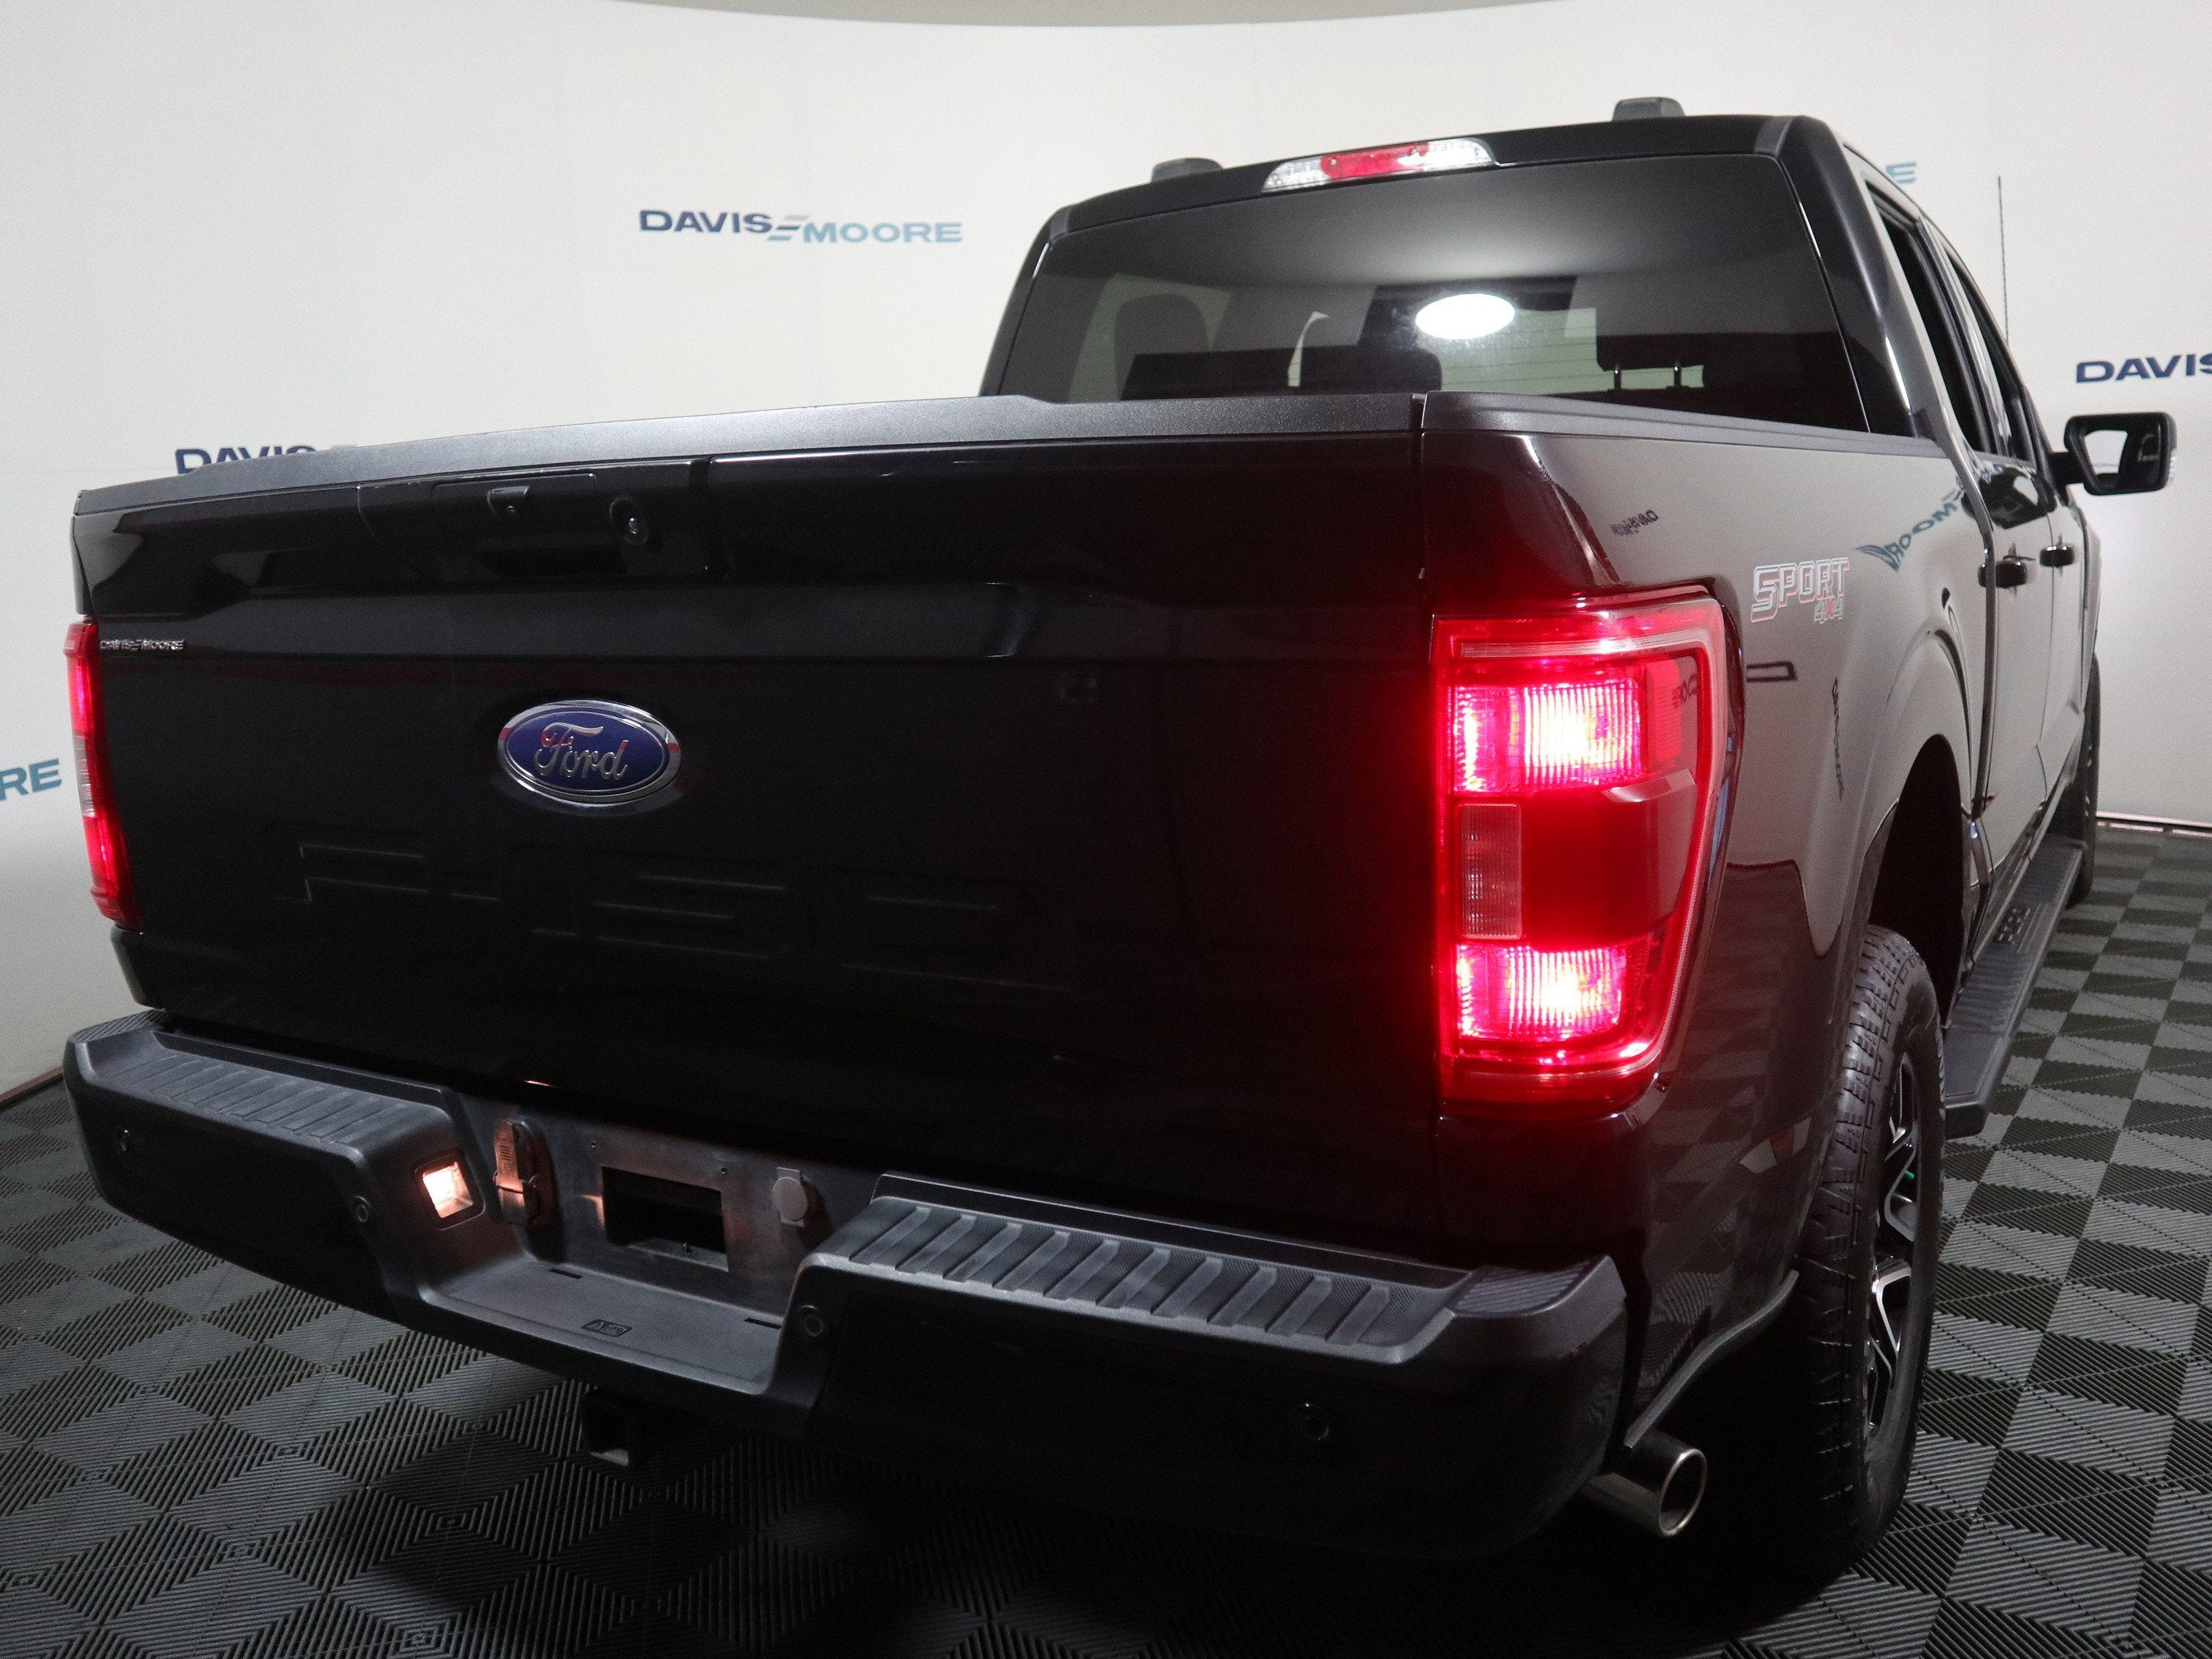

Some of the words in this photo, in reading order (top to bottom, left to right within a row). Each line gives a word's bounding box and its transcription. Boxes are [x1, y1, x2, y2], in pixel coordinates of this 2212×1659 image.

[639, 210, 772, 233] DAVIS
[803, 222, 963, 243] MOORE
[1751, 556, 1850, 624] SPORT
[534, 721, 629, 780] Ford
